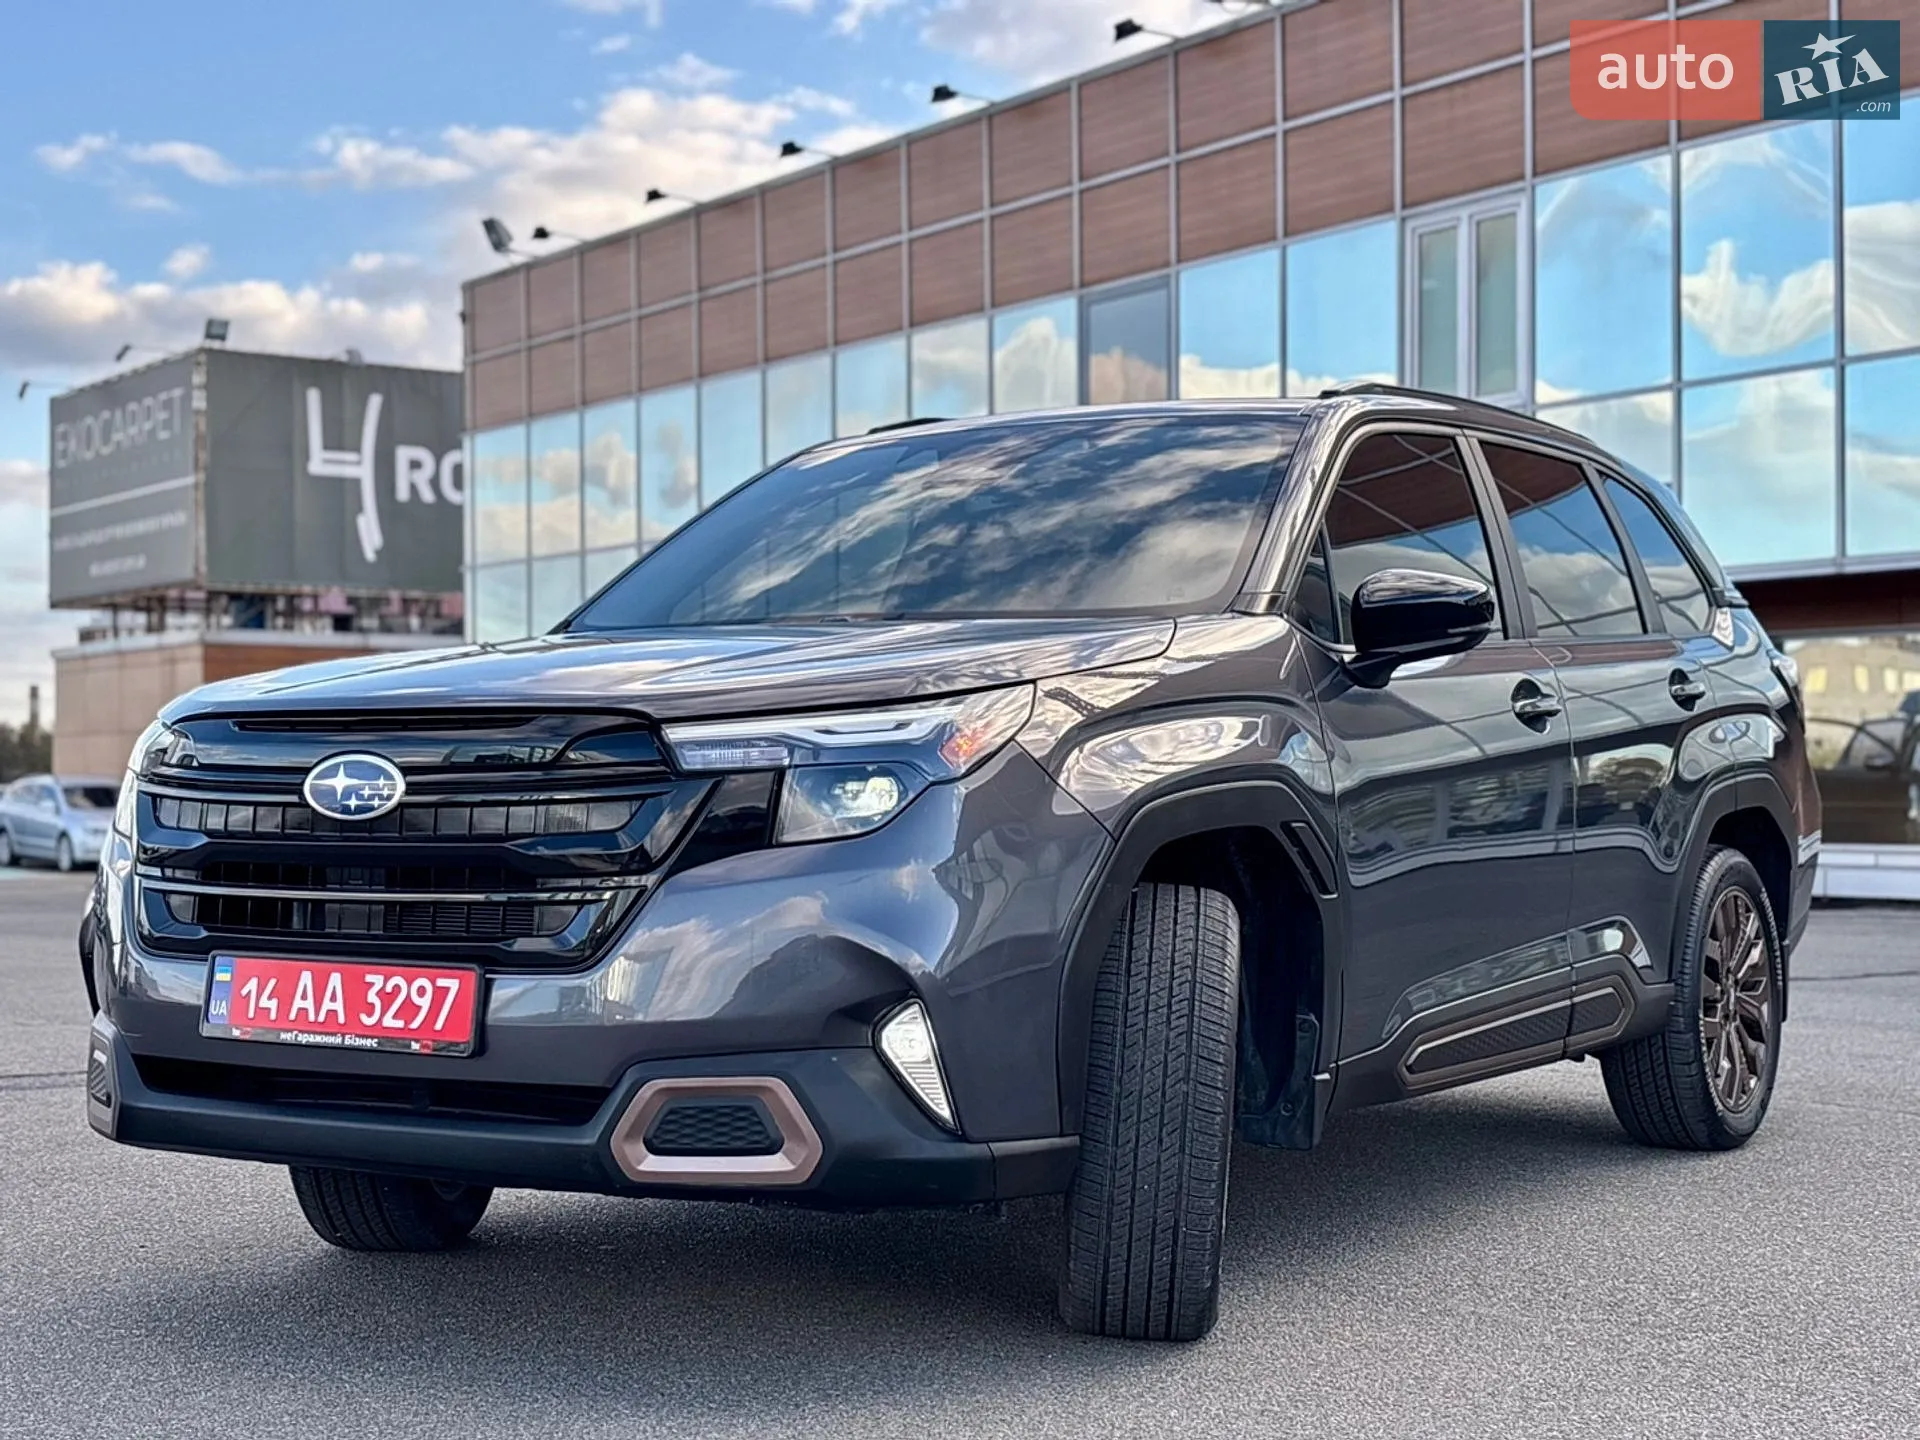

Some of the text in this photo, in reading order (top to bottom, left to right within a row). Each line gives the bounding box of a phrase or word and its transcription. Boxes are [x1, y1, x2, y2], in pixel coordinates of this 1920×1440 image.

[54, 386, 185, 469] EKOCARPET
[210, 999, 228, 1016] UA
[240, 970, 460, 1032] 14 AA 3297
[344, 1034, 378, 1048] Бізнес
